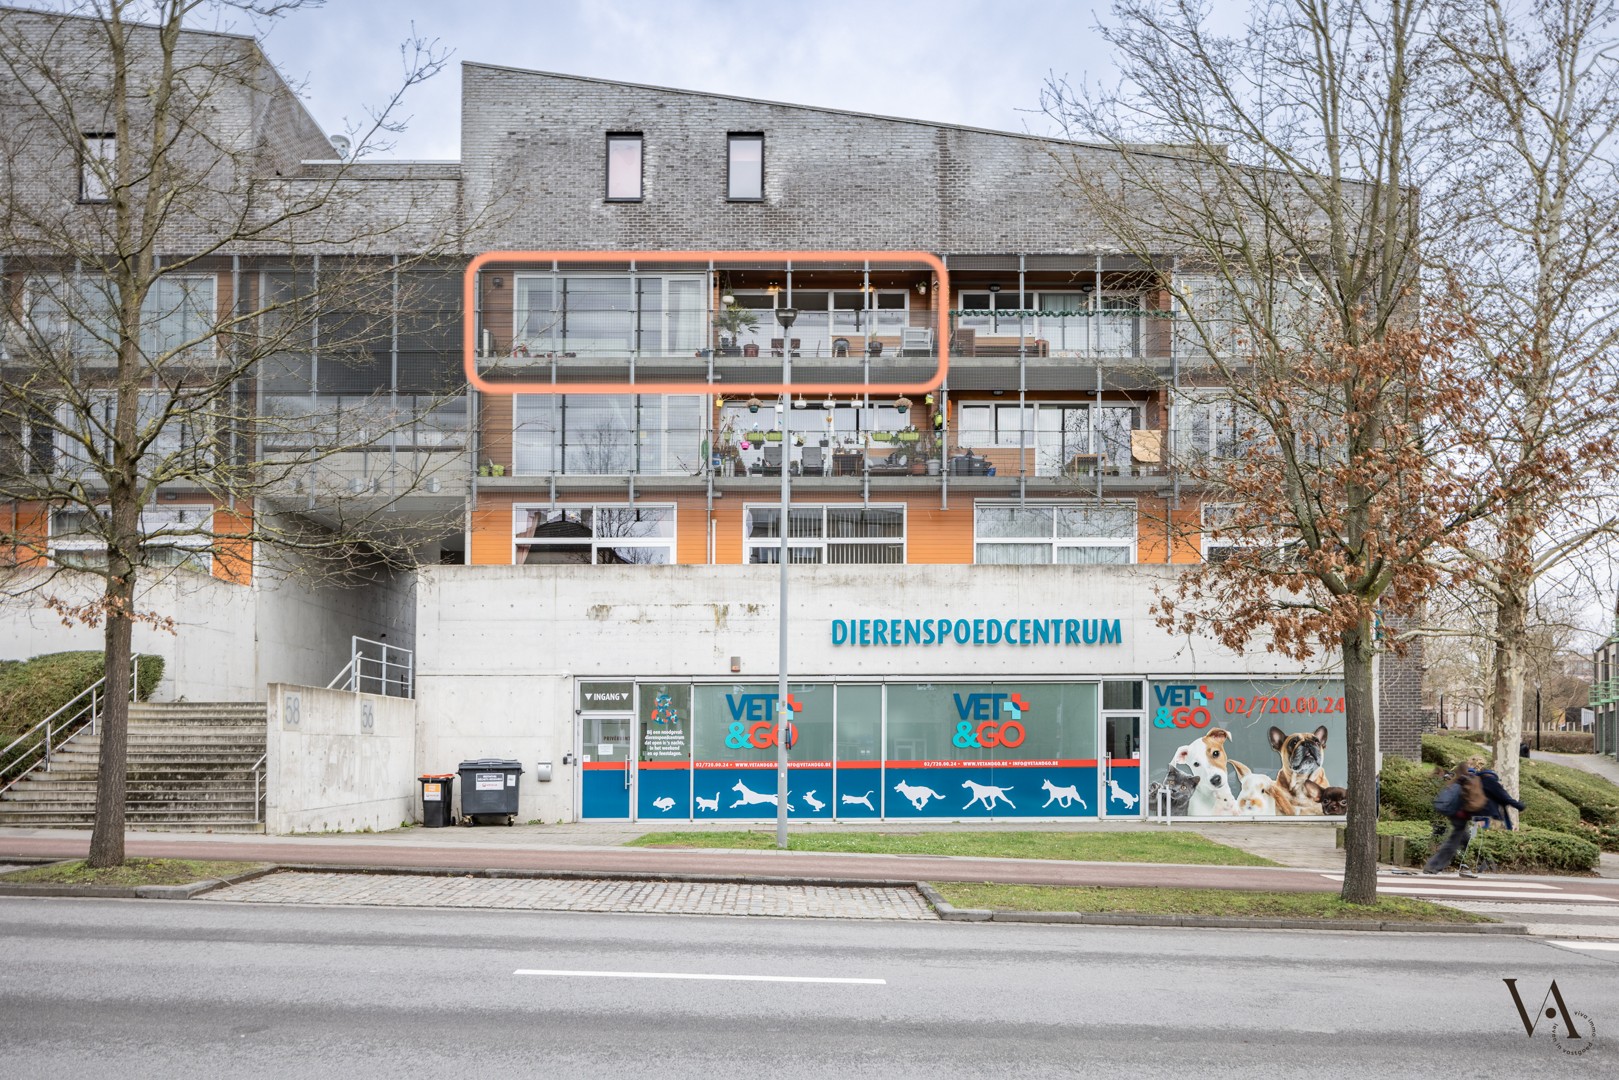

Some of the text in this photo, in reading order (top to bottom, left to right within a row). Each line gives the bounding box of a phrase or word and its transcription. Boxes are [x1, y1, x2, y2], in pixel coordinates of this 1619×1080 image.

[831, 618, 1122, 645] DIERENSPOEDCENTRUM
[593, 693, 620, 701] INGANG
[725, 693, 780, 721] VET
[953, 693, 1008, 720] VET
[1154, 685, 1197, 706] VET
[1224, 696, 1345, 718] 02/720.00.24
[286, 697, 300, 724] 58
[362, 704, 374, 728] 56
[1153, 706, 1211, 729] &GO
[952, 720, 1026, 748] &GO
